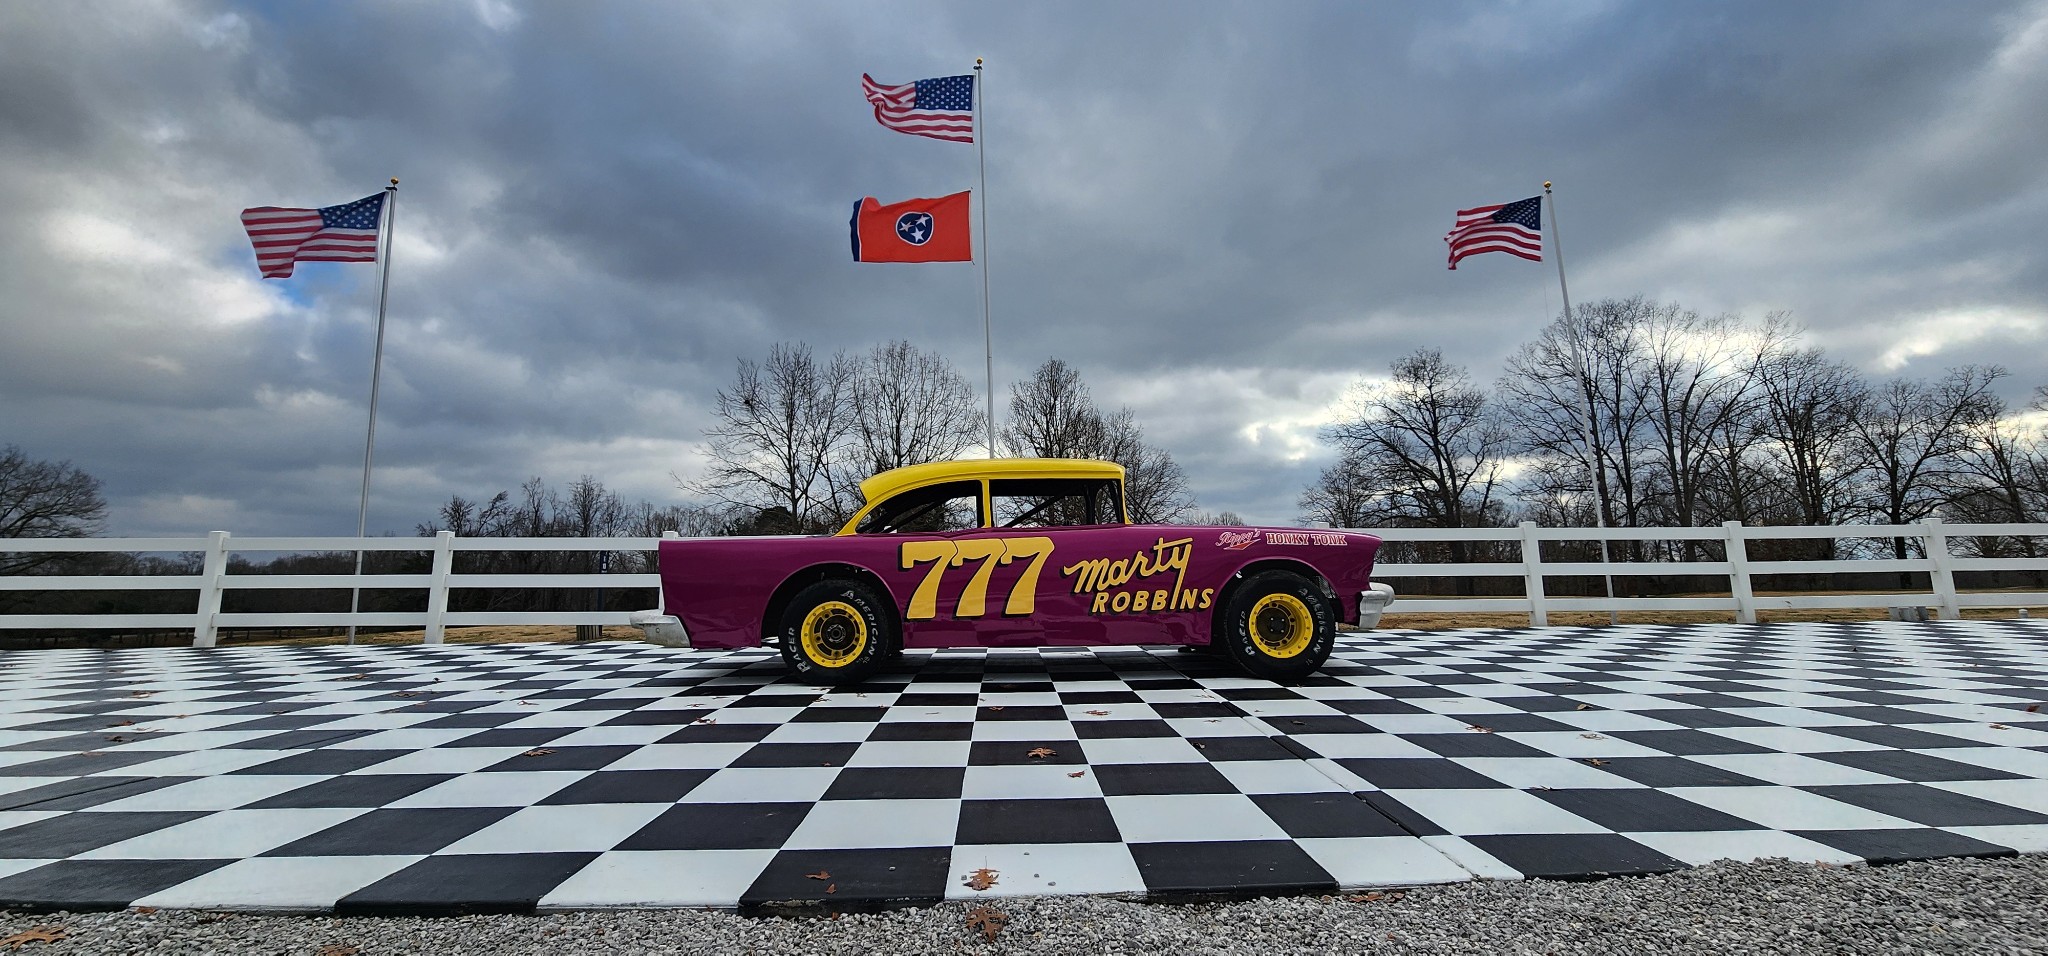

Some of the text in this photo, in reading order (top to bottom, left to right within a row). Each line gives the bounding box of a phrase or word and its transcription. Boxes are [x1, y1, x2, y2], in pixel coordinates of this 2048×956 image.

[1266, 532, 1309, 546] HONKY
[1311, 533, 1348, 546] TONK
[901, 536, 1055, 619] 777
[1091, 587, 1214, 614] ROBBINS
[840, 590, 878, 656] AMERICAN
[788, 627, 812, 673] RACER
